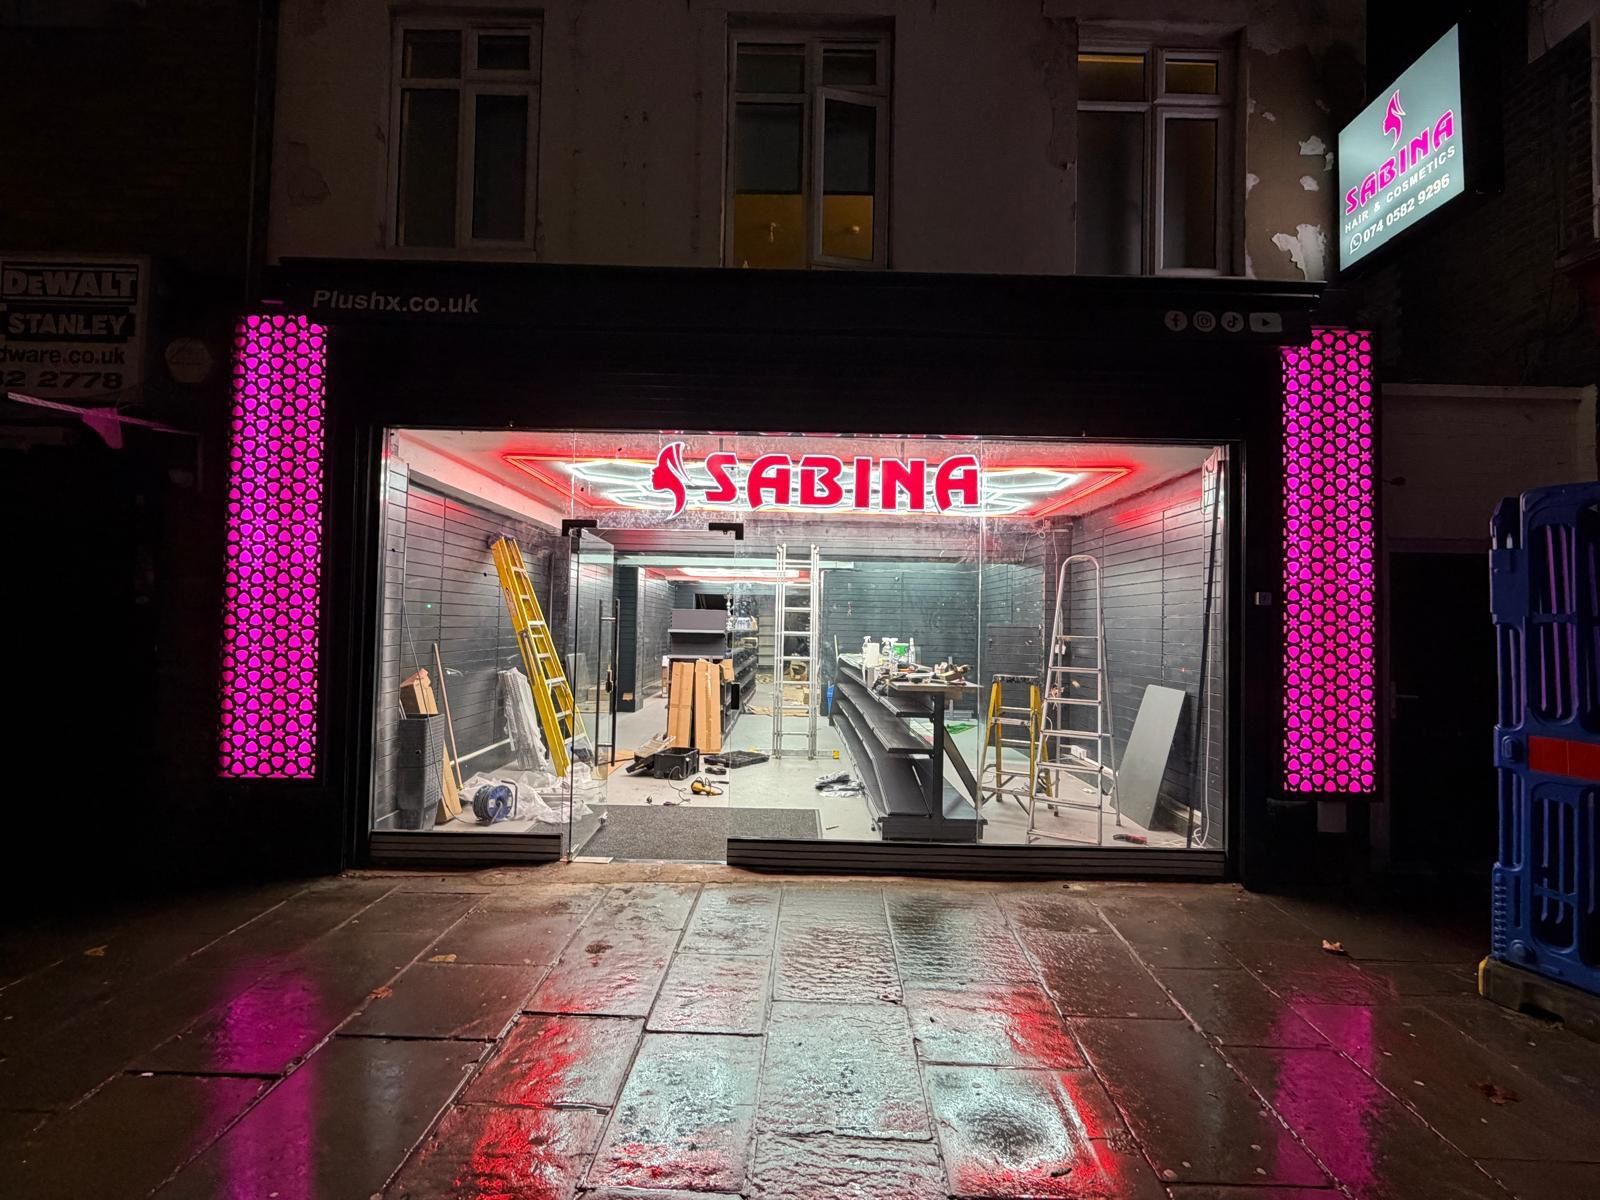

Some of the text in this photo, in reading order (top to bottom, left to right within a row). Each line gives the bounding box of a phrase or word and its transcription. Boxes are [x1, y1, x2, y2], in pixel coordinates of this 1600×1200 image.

[1344, 109, 1455, 216] SABINA
[1345, 145, 1456, 233] HAIR & COSMETICS
[1362, 173, 1450, 243] 074 0582 9296
[8, 312, 126, 335] STANLEY
[313, 289, 479, 313] Plushx.co.uk
[0, 370, 123, 389] 2 2778
[705, 451, 980, 513] SABINA
